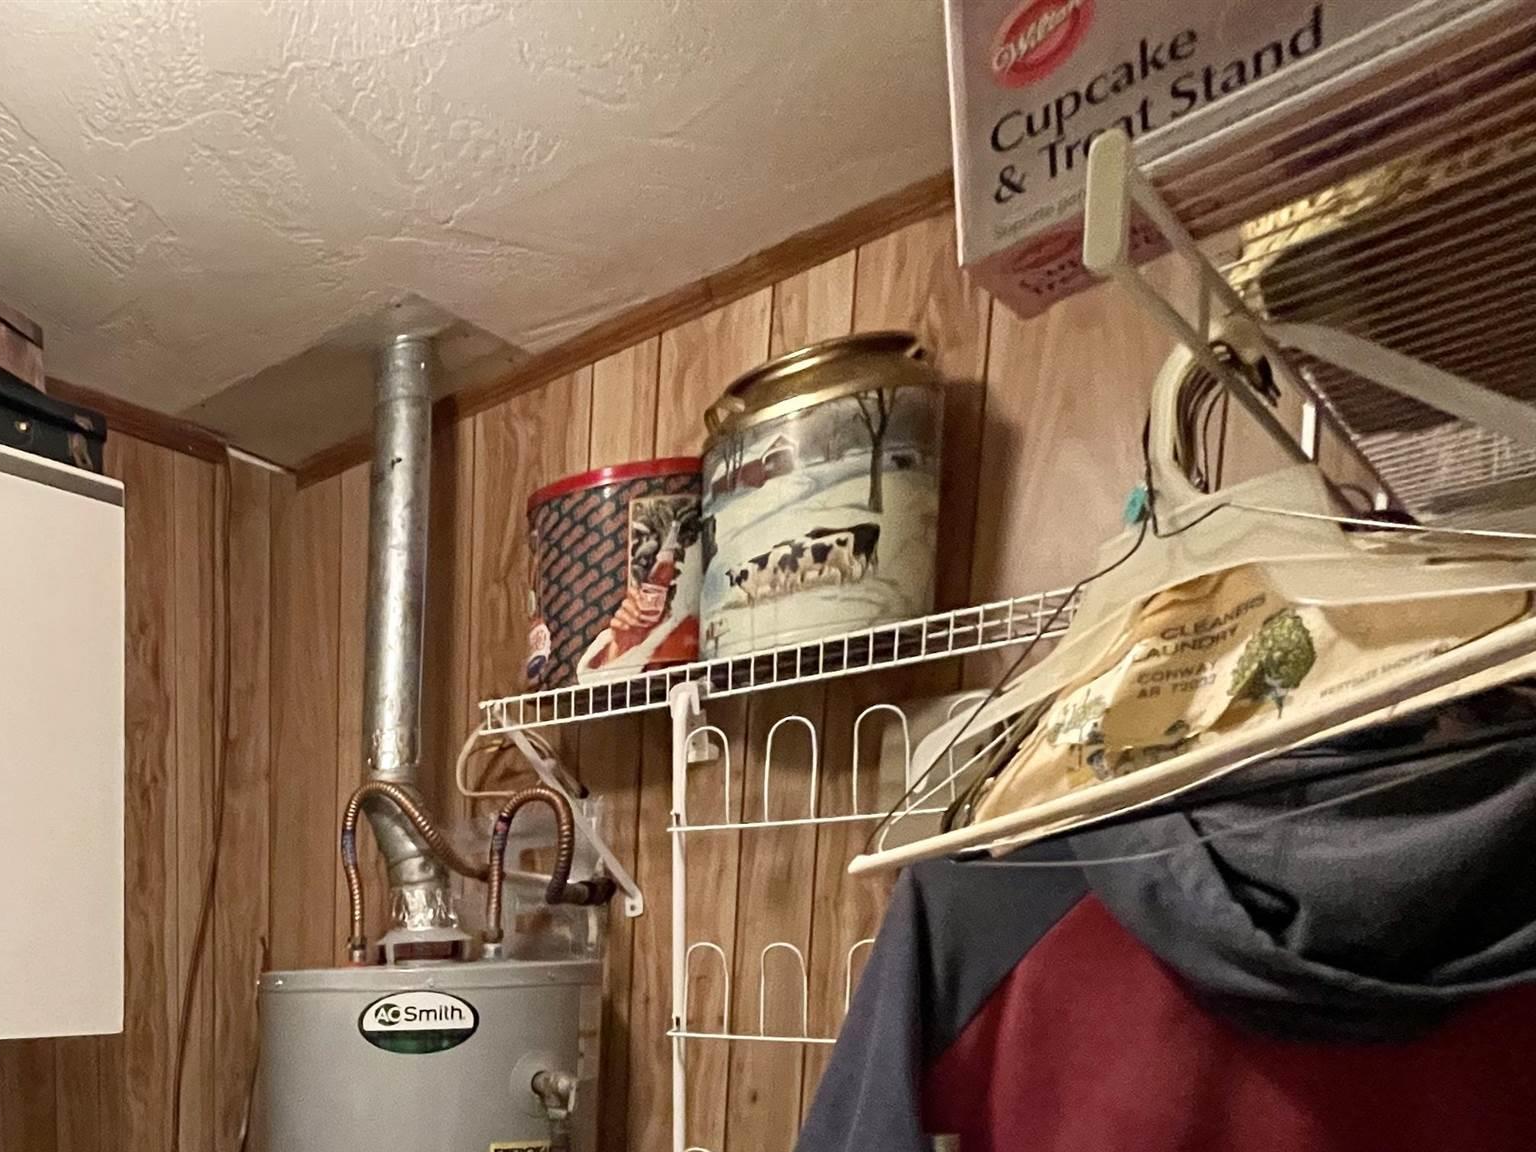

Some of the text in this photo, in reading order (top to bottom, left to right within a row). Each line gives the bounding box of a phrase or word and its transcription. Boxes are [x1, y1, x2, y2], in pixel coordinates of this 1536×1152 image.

[990, 28, 1198, 152] Cupcake
[994, 165, 1027, 205] &
[1170, 3, 1324, 119] Stand
[1159, 592, 1267, 640] CLEANERS
[403, 1005, 463, 1022] Smith
